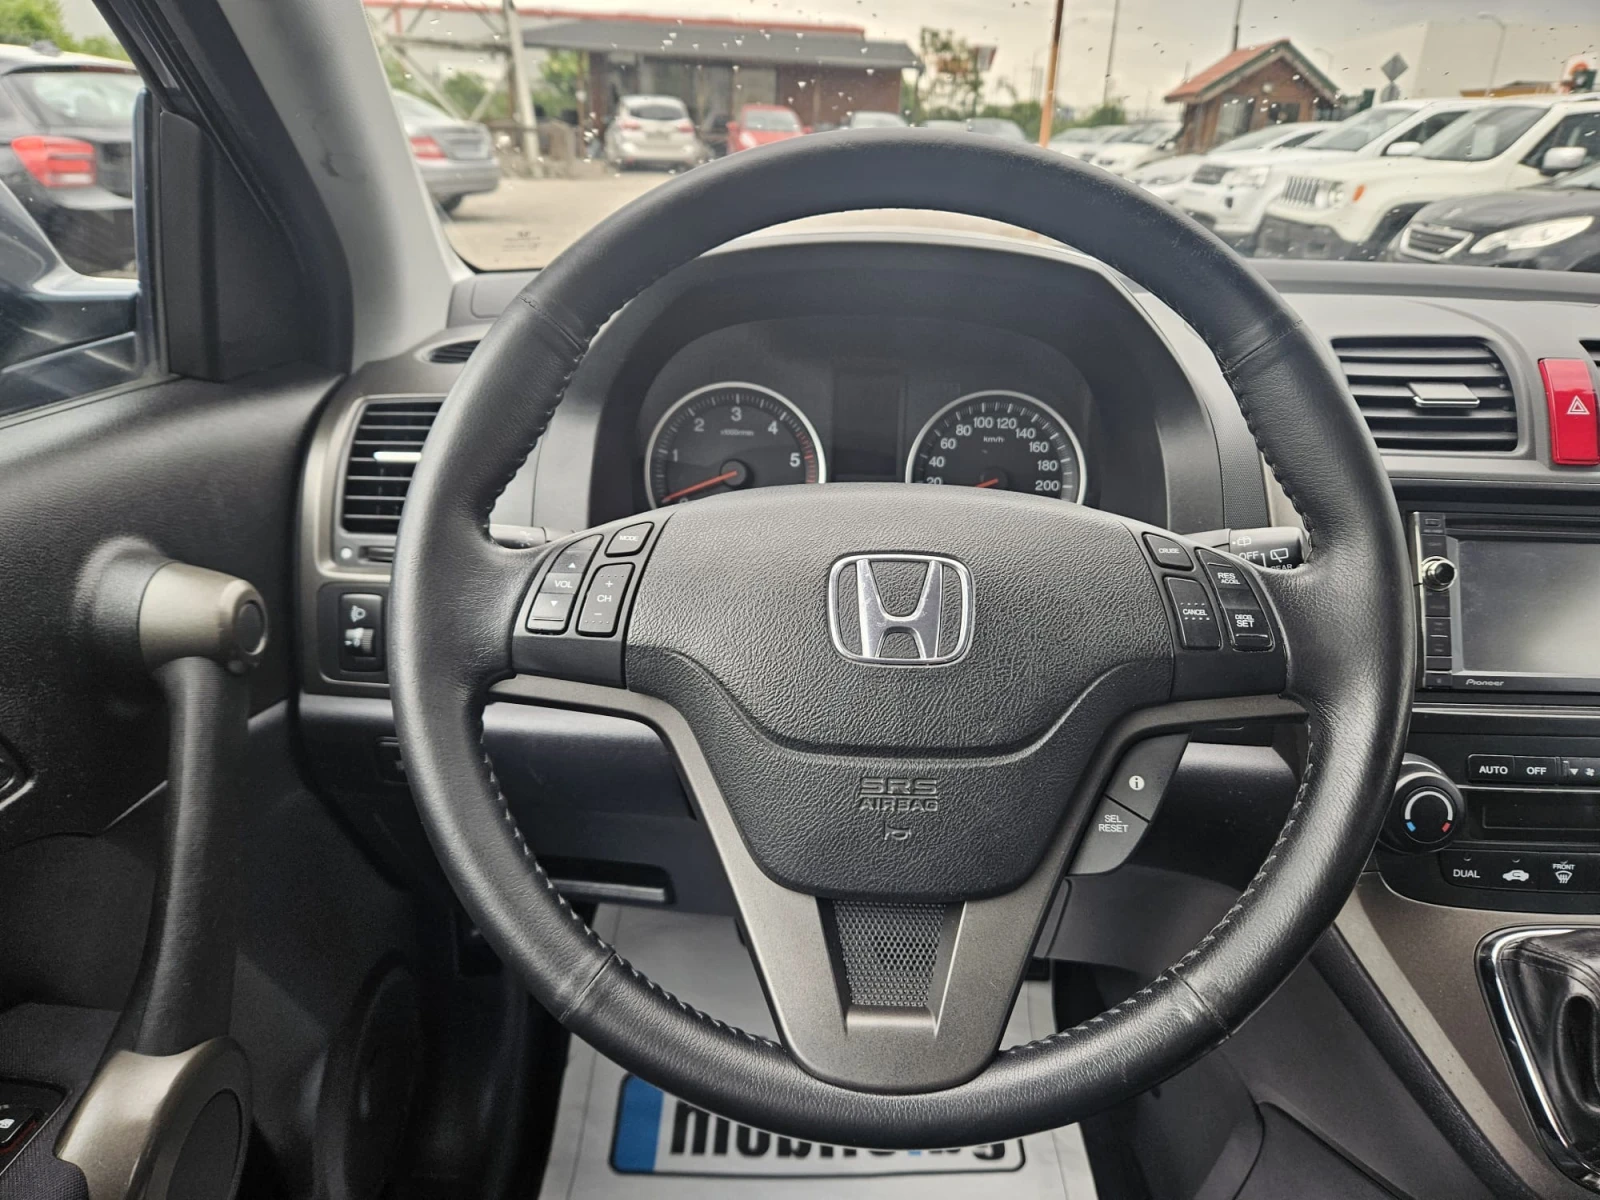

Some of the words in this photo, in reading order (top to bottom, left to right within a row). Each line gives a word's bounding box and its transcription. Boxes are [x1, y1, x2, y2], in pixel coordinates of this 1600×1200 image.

[731, 407, 742, 421] 3
[693, 418, 705, 432] 2
[767, 420, 778, 435] 4
[973, 416, 993, 428] 100
[997, 417, 1017, 429] 120
[956, 424, 972, 436] 80
[1015, 427, 1036, 439] 140
[940, 438, 956, 449] 60
[983, 435, 1004, 443] km/h
[1029, 441, 1048, 453] 160
[672, 449, 679, 462] 1
[789, 453, 800, 467] 5
[929, 456, 945, 467] 40
[1037, 461, 1058, 472] 180
[1035, 480, 1060, 491] 200
[1239, 550, 1259, 561] OFF
[1217, 572, 1236, 580] RES
[554, 580, 573, 589] VOL
[596, 594, 612, 603] CH
[1182, 608, 1208, 616] CANCEL
[1236, 619, 1255, 628] SET
[1479, 765, 1509, 775] AUTO
[1526, 766, 1547, 776] OFF
[860, 776, 938, 795] SRS
[860, 798, 939, 812] AIRBAG
[1104, 814, 1123, 824] SEL
[1098, 823, 1129, 833] RESET
[1552, 862, 1576, 871] FRONT
[1453, 868, 1481, 878] DUAL
